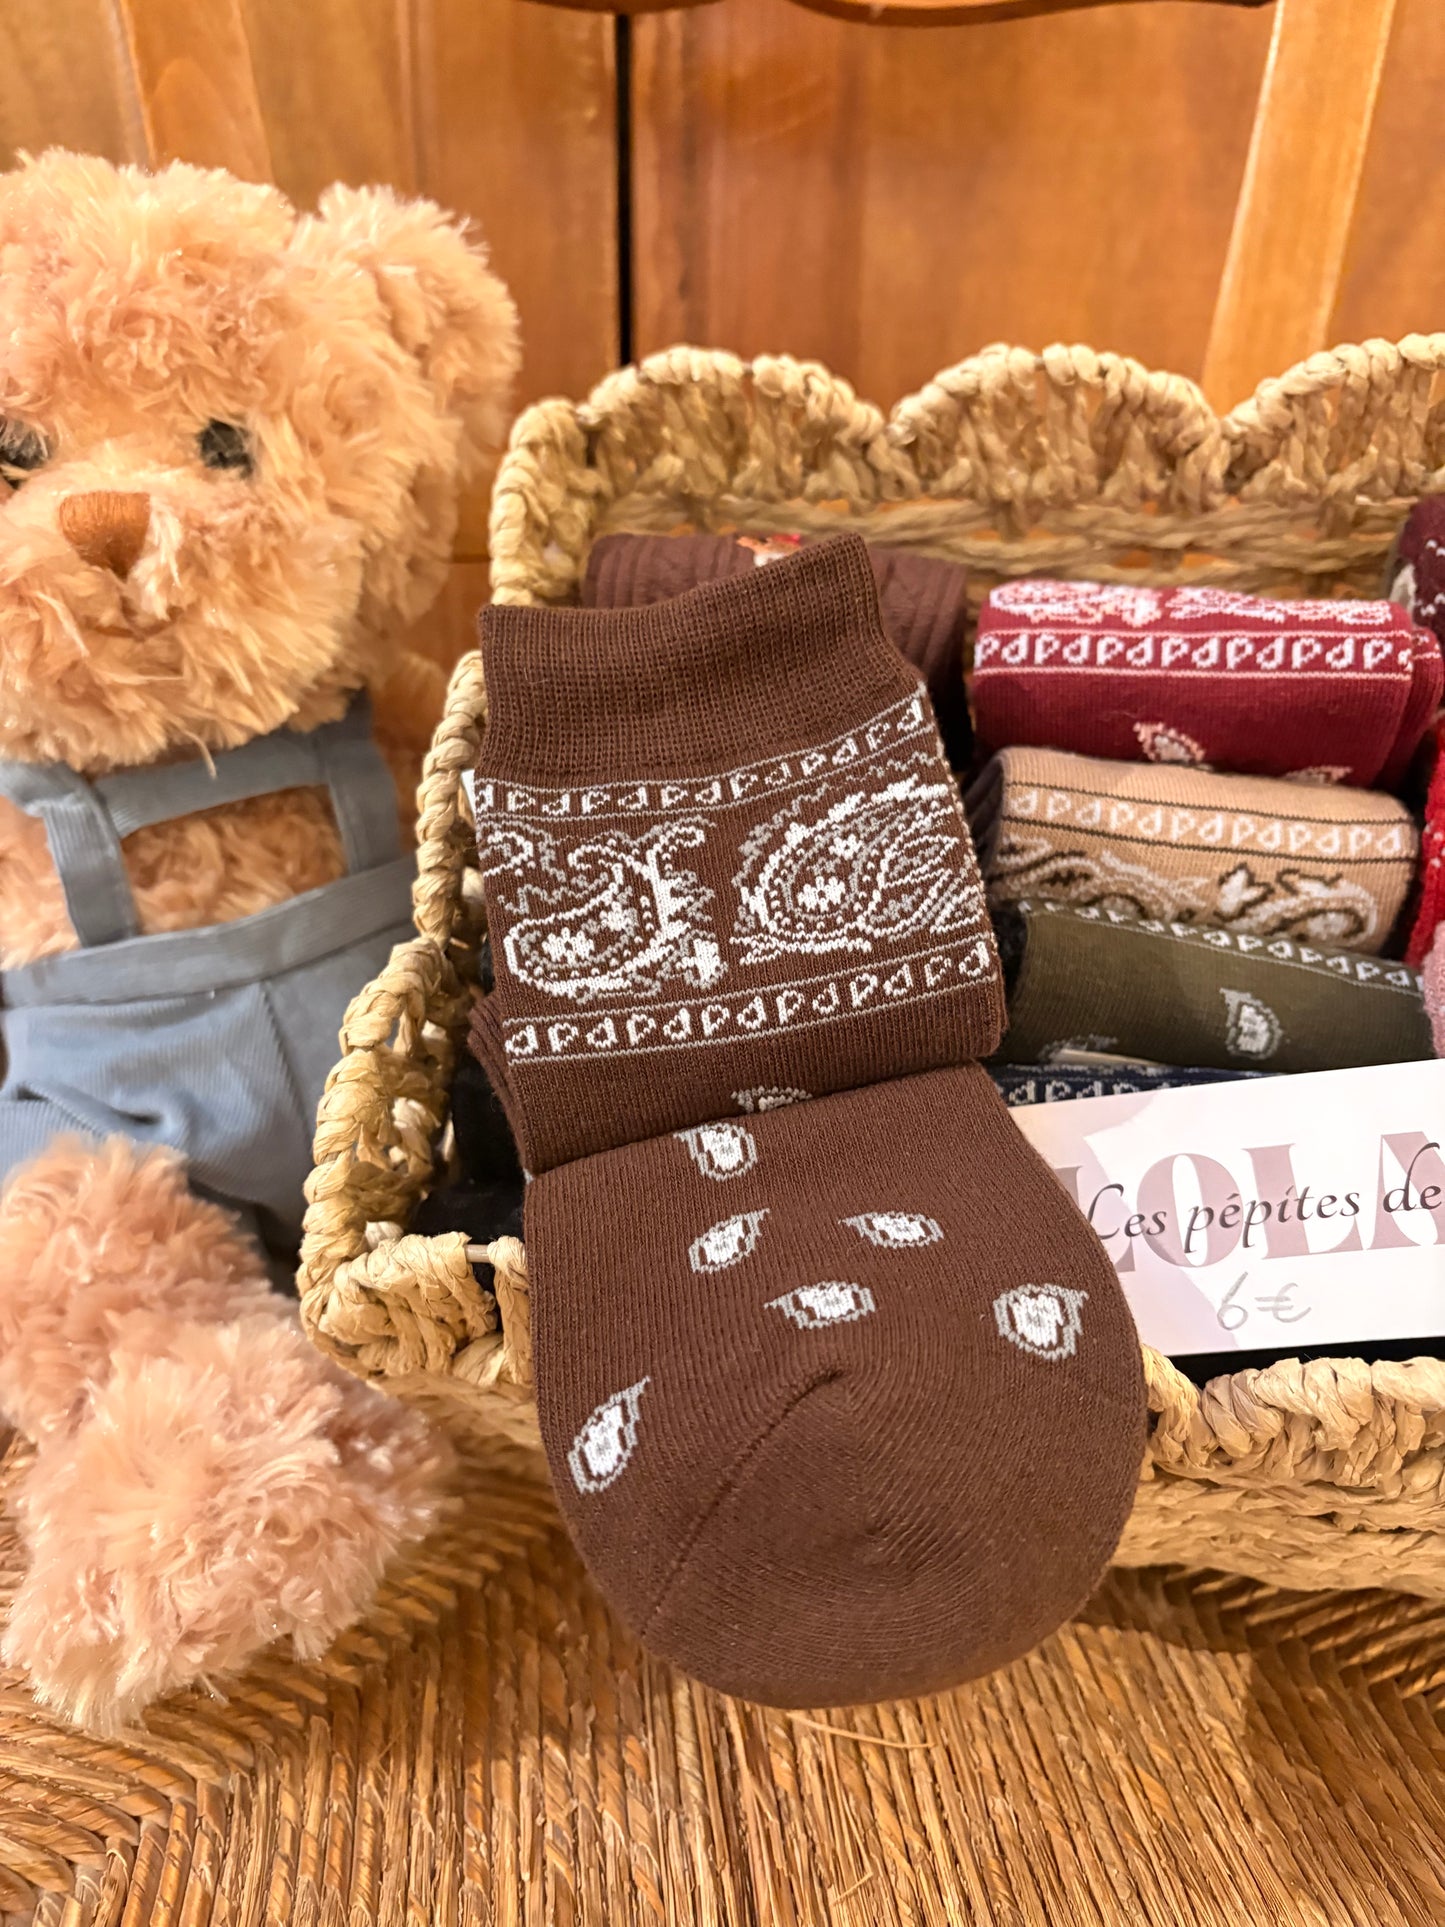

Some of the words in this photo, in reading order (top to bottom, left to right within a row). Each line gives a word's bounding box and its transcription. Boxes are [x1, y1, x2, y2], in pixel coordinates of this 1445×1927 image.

[1087, 1183, 1167, 1240] Les
[1183, 1184, 1361, 1254] pépites
[1382, 1142, 1442, 1213] de
[1216, 1271, 1312, 1331] 6€
